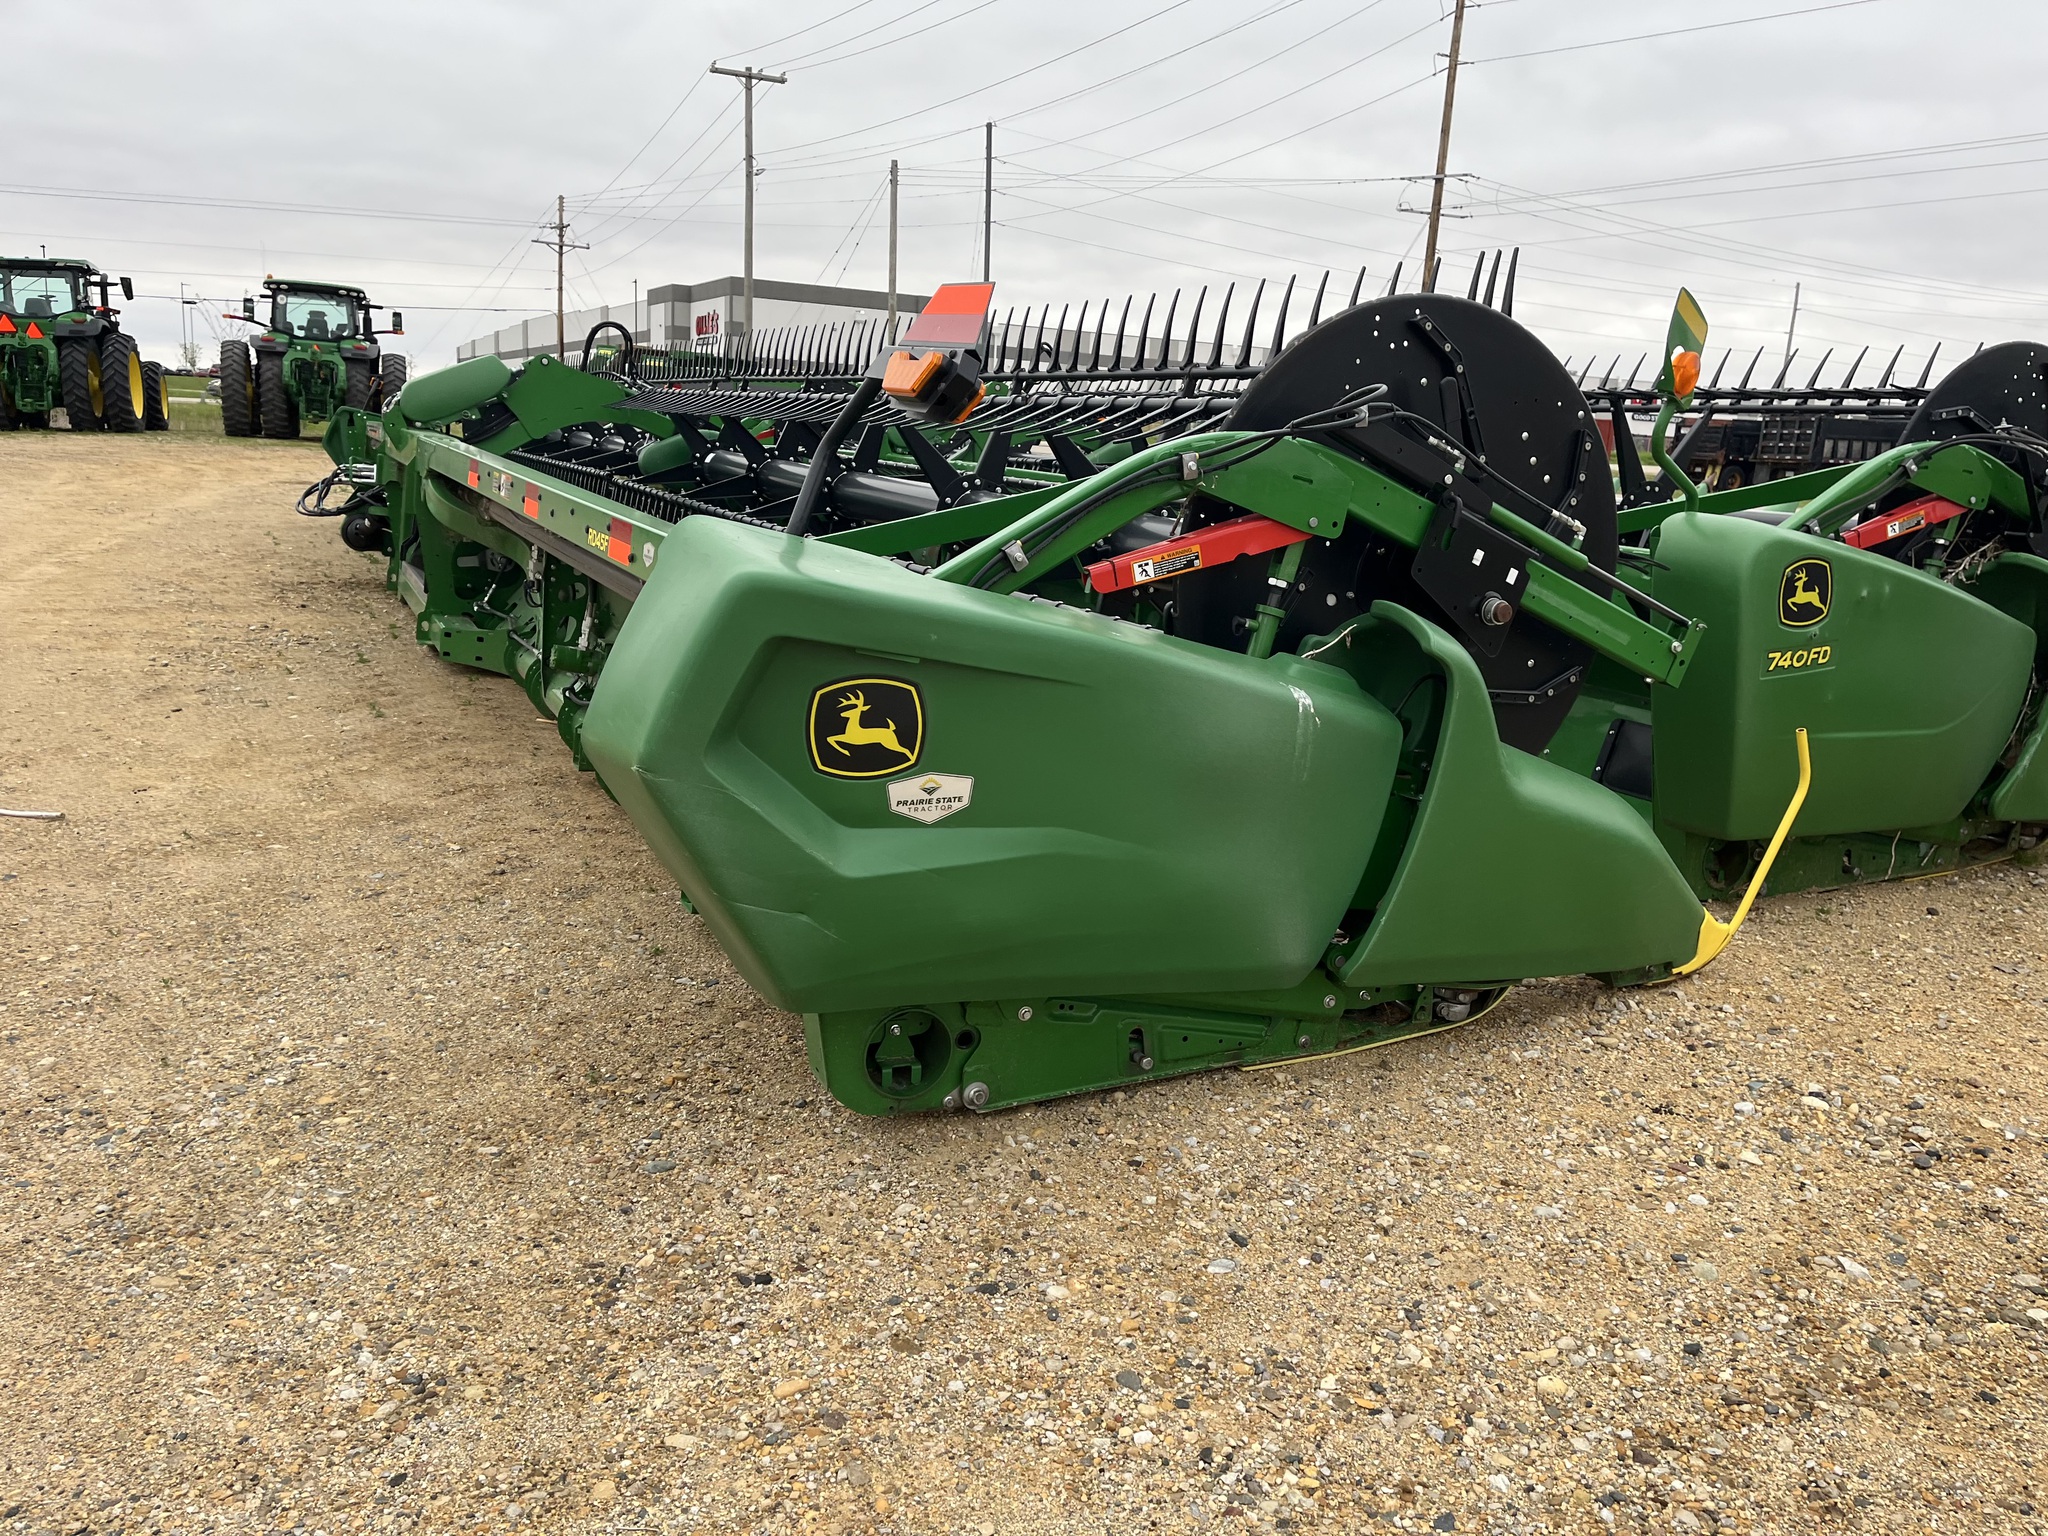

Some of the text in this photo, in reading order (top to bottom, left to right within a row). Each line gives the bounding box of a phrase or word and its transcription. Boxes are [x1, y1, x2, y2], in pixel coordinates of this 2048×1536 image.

[588, 527, 609, 552] RD45F
[1167, 548, 1193, 558] WARNING
[1767, 645, 1831, 672] 740FD
[896, 796, 964, 807] PRAIRIE STATE
[908, 804, 953, 813] TRACTOR
